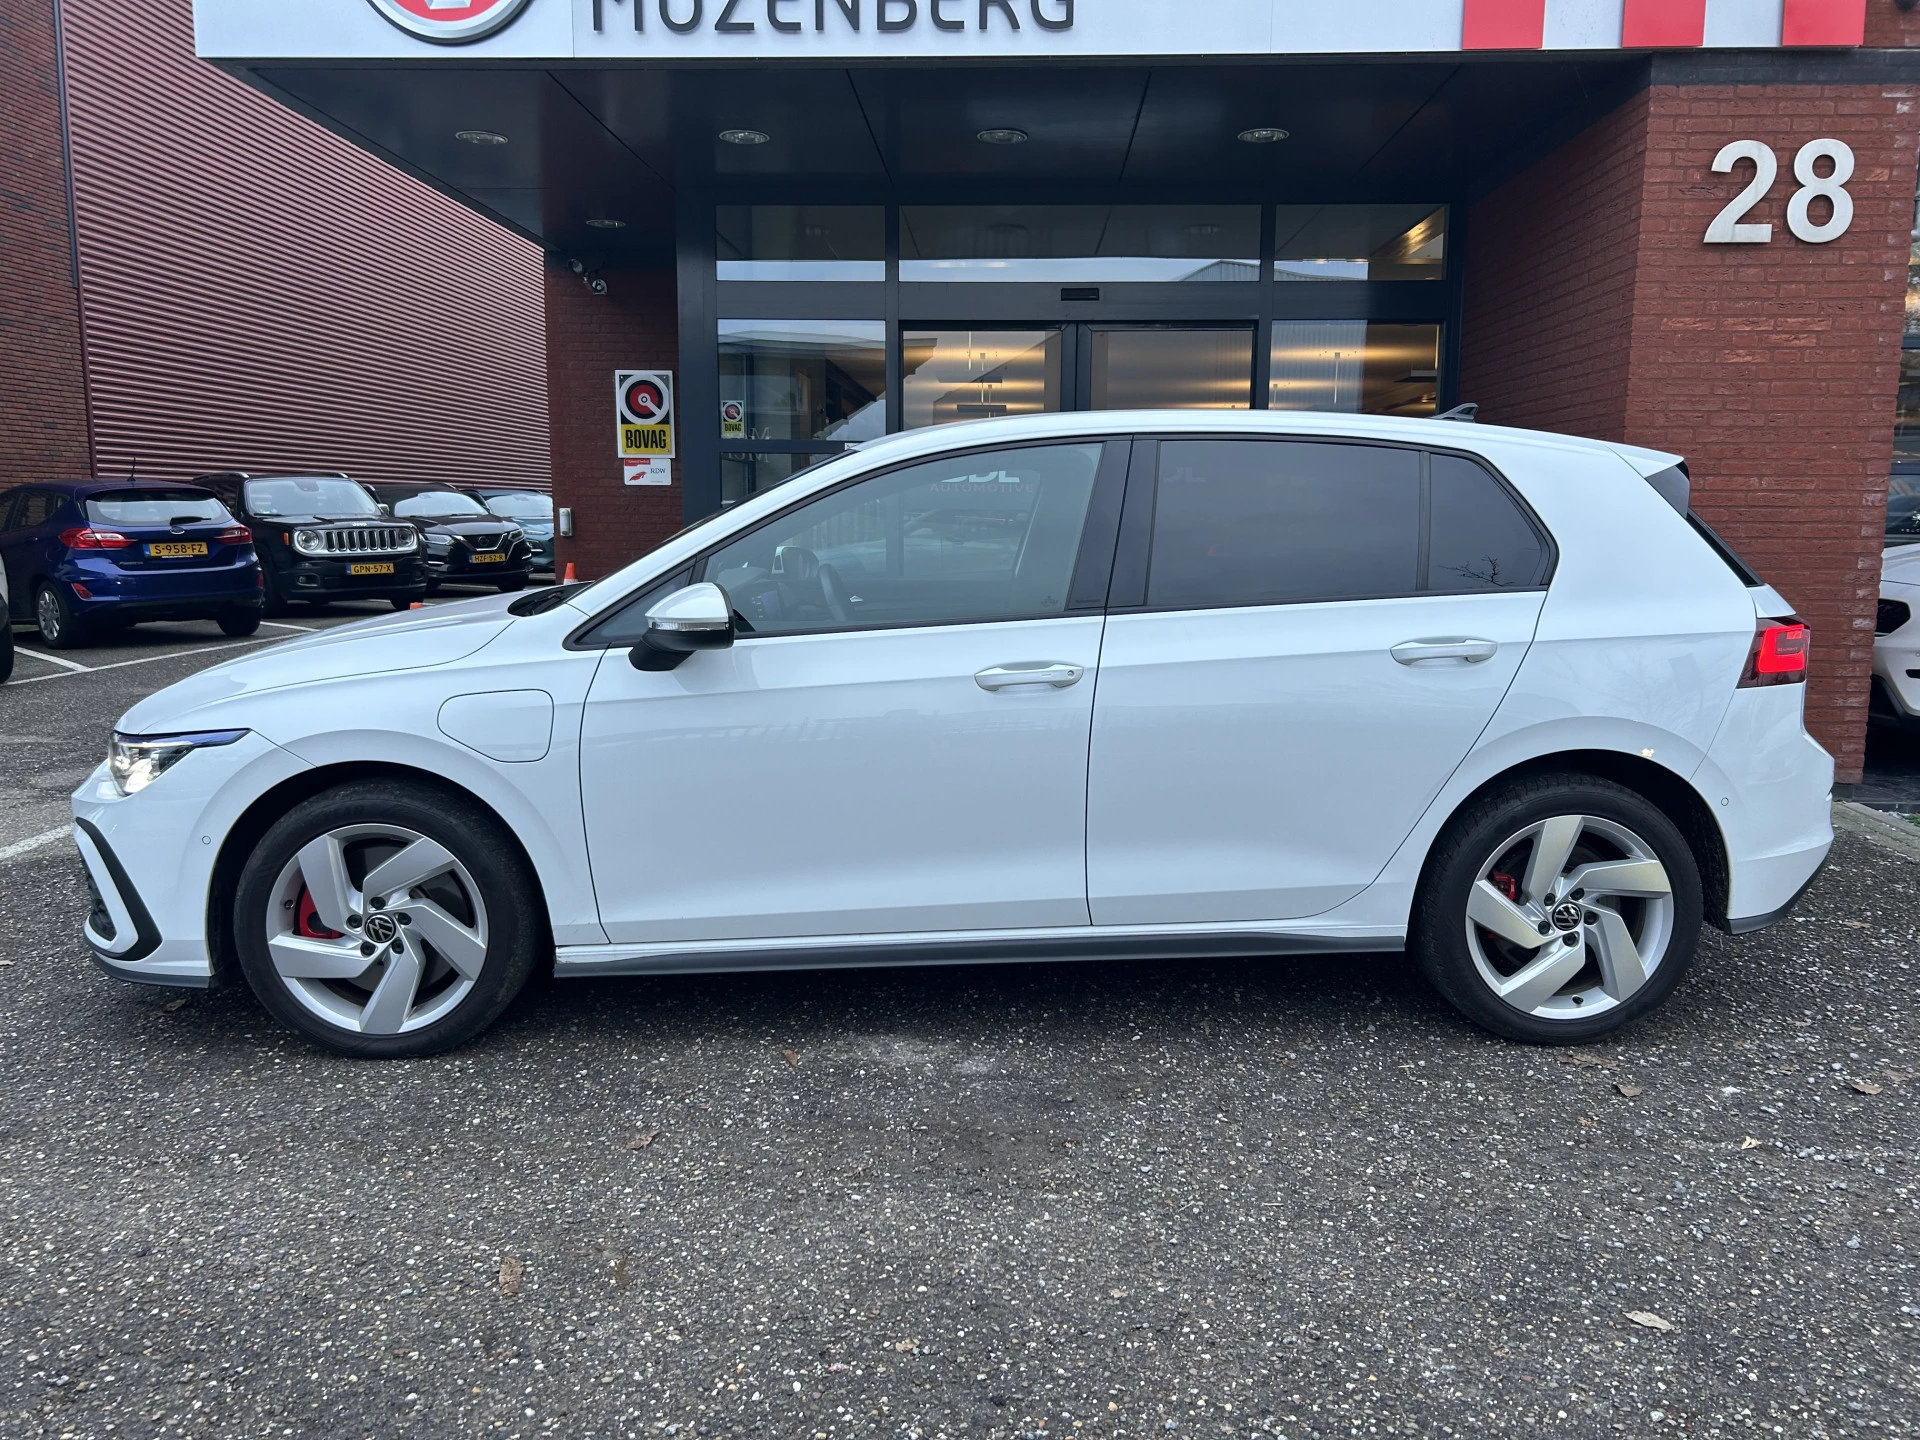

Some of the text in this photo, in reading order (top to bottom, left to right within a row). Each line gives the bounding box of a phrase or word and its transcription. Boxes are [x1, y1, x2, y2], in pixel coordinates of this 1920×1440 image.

[1704, 138, 1855, 244] 28
[724, 423, 742, 432] BOVAG
[625, 429, 667, 449] BOVAG
[930, 483, 1034, 493] AUTOMOTIVE
[154, 543, 204, 555] S-958-FZ
[353, 564, 392, 574] GPN-57-X
